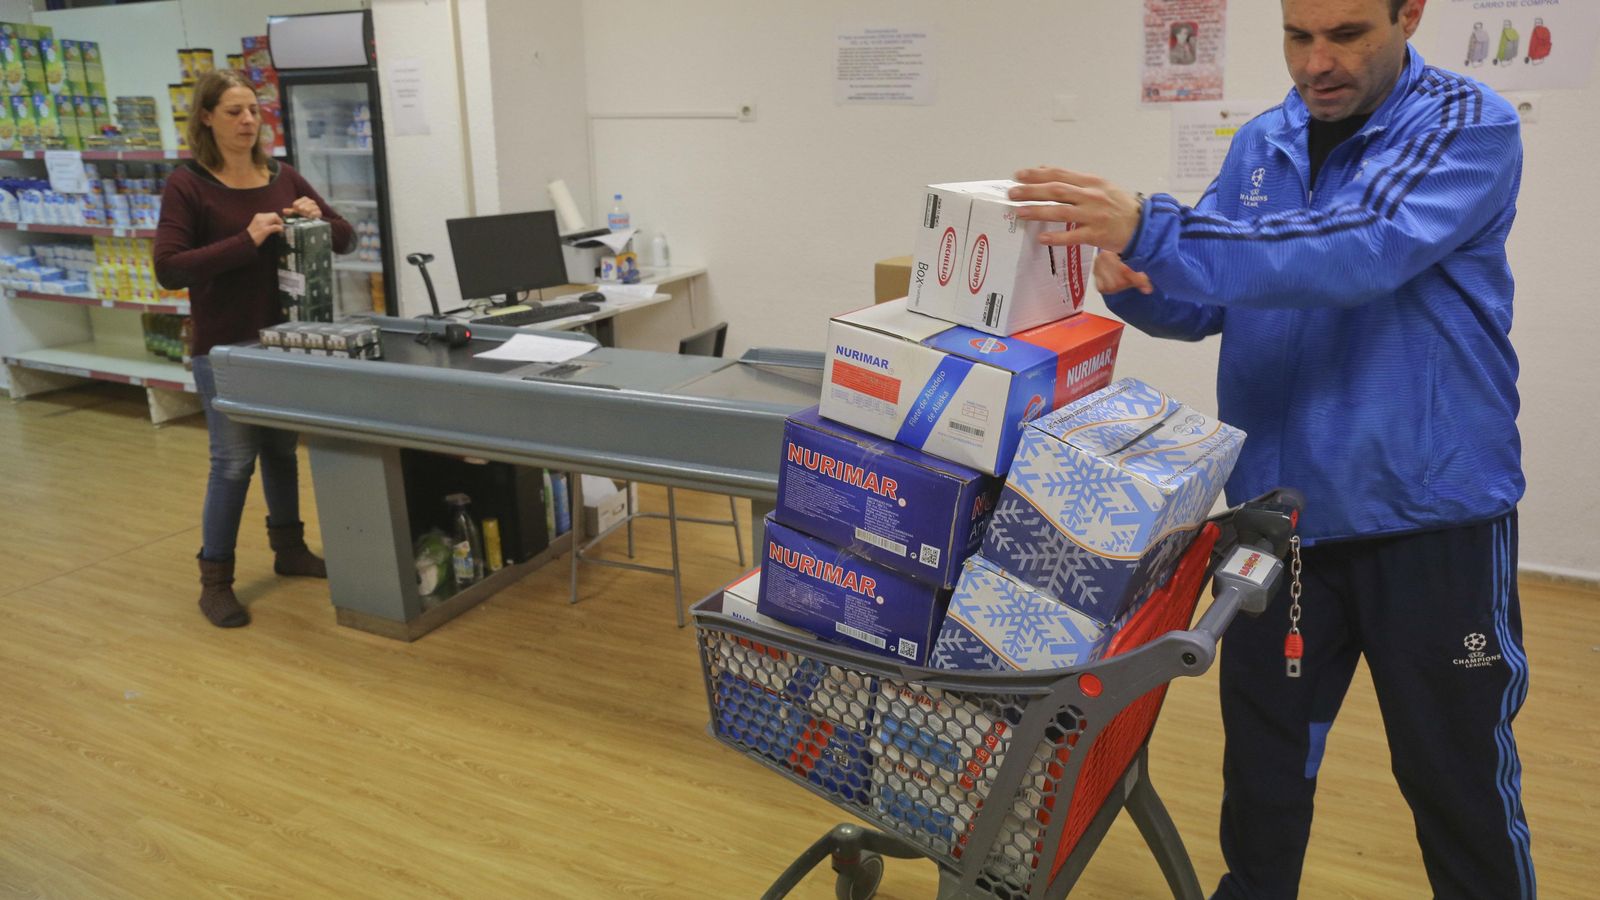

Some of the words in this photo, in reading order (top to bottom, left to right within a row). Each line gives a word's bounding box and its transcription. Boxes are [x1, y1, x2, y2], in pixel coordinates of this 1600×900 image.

[940, 233, 953, 281] CARCHELEJO
[971, 239, 986, 289] CARCHELEJO
[836, 344, 889, 370] NURIMAR
[1066, 347, 1112, 388] NURIMAR
[908, 408, 921, 427] Filete
[920, 399, 928, 410] de
[925, 370, 946, 400] Abadejo
[928, 413, 936, 423] de
[932, 391, 950, 414] Alaska
[787, 442, 898, 500] NURIMAR
[769, 541, 876, 598] NURIMAR
[1452, 654, 1501, 664] CHAMPIONS
